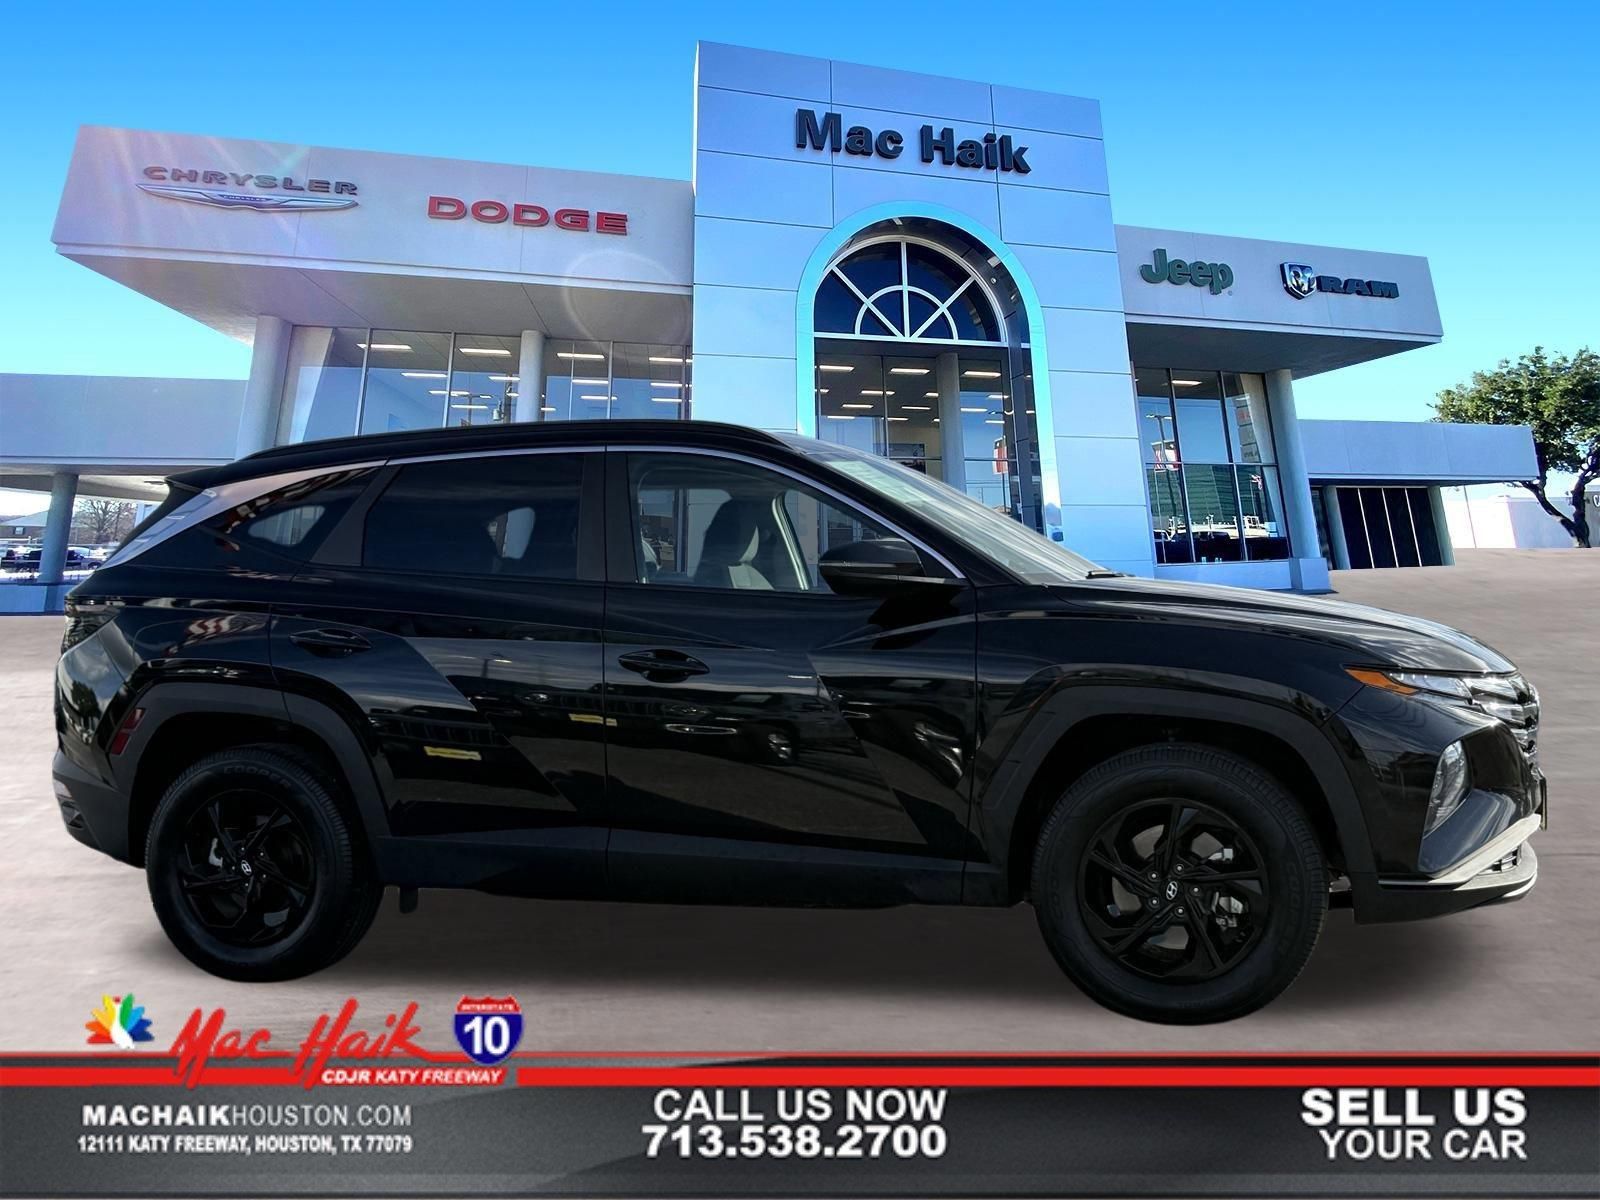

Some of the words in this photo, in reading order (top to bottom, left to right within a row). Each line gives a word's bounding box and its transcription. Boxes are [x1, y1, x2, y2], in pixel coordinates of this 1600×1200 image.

[794, 108, 904, 160] Mac
[919, 124, 1032, 174] Haik
[143, 165, 358, 196] CHRYSLER
[428, 196, 628, 236] DODGE
[1140, 248, 1234, 296] Jeep
[1316, 275, 1400, 299] RAM
